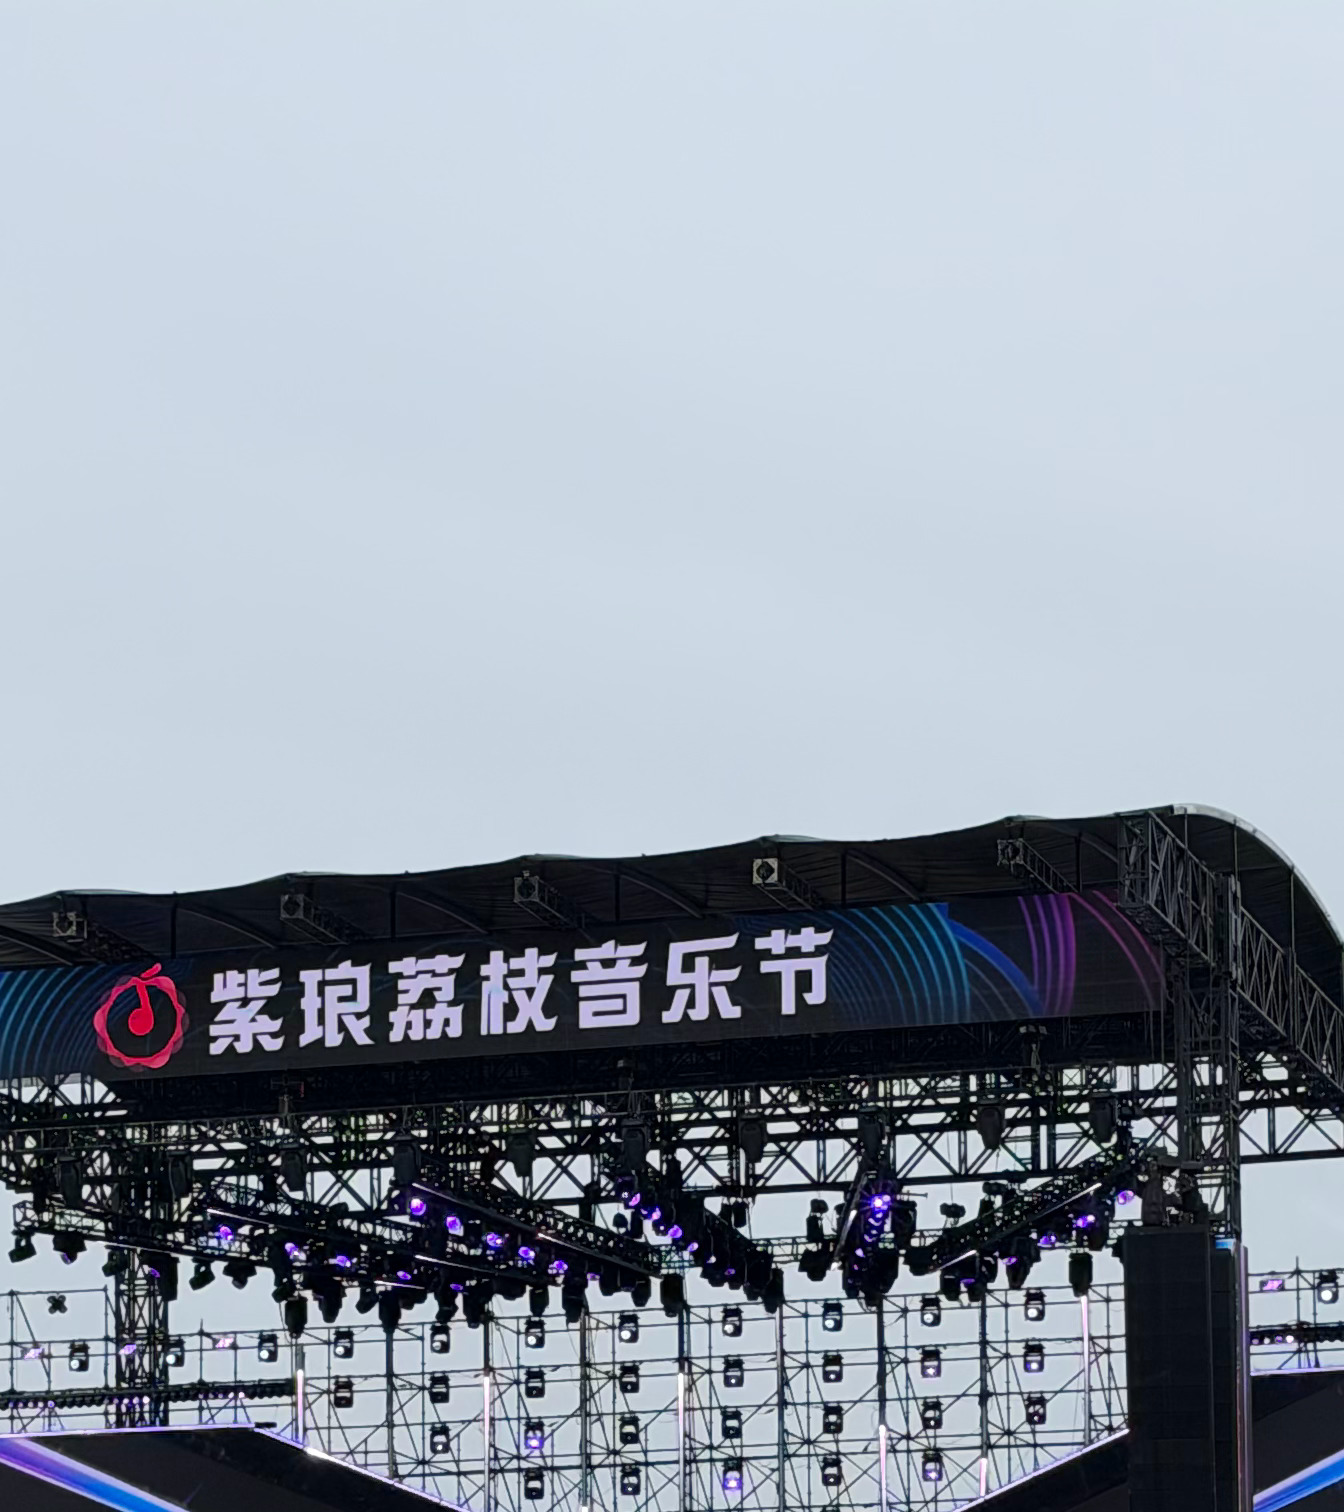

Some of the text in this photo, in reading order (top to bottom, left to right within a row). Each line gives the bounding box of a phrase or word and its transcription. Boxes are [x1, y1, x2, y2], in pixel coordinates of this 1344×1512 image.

[208, 926, 835, 1055] 紫琅荔枝音乐节
